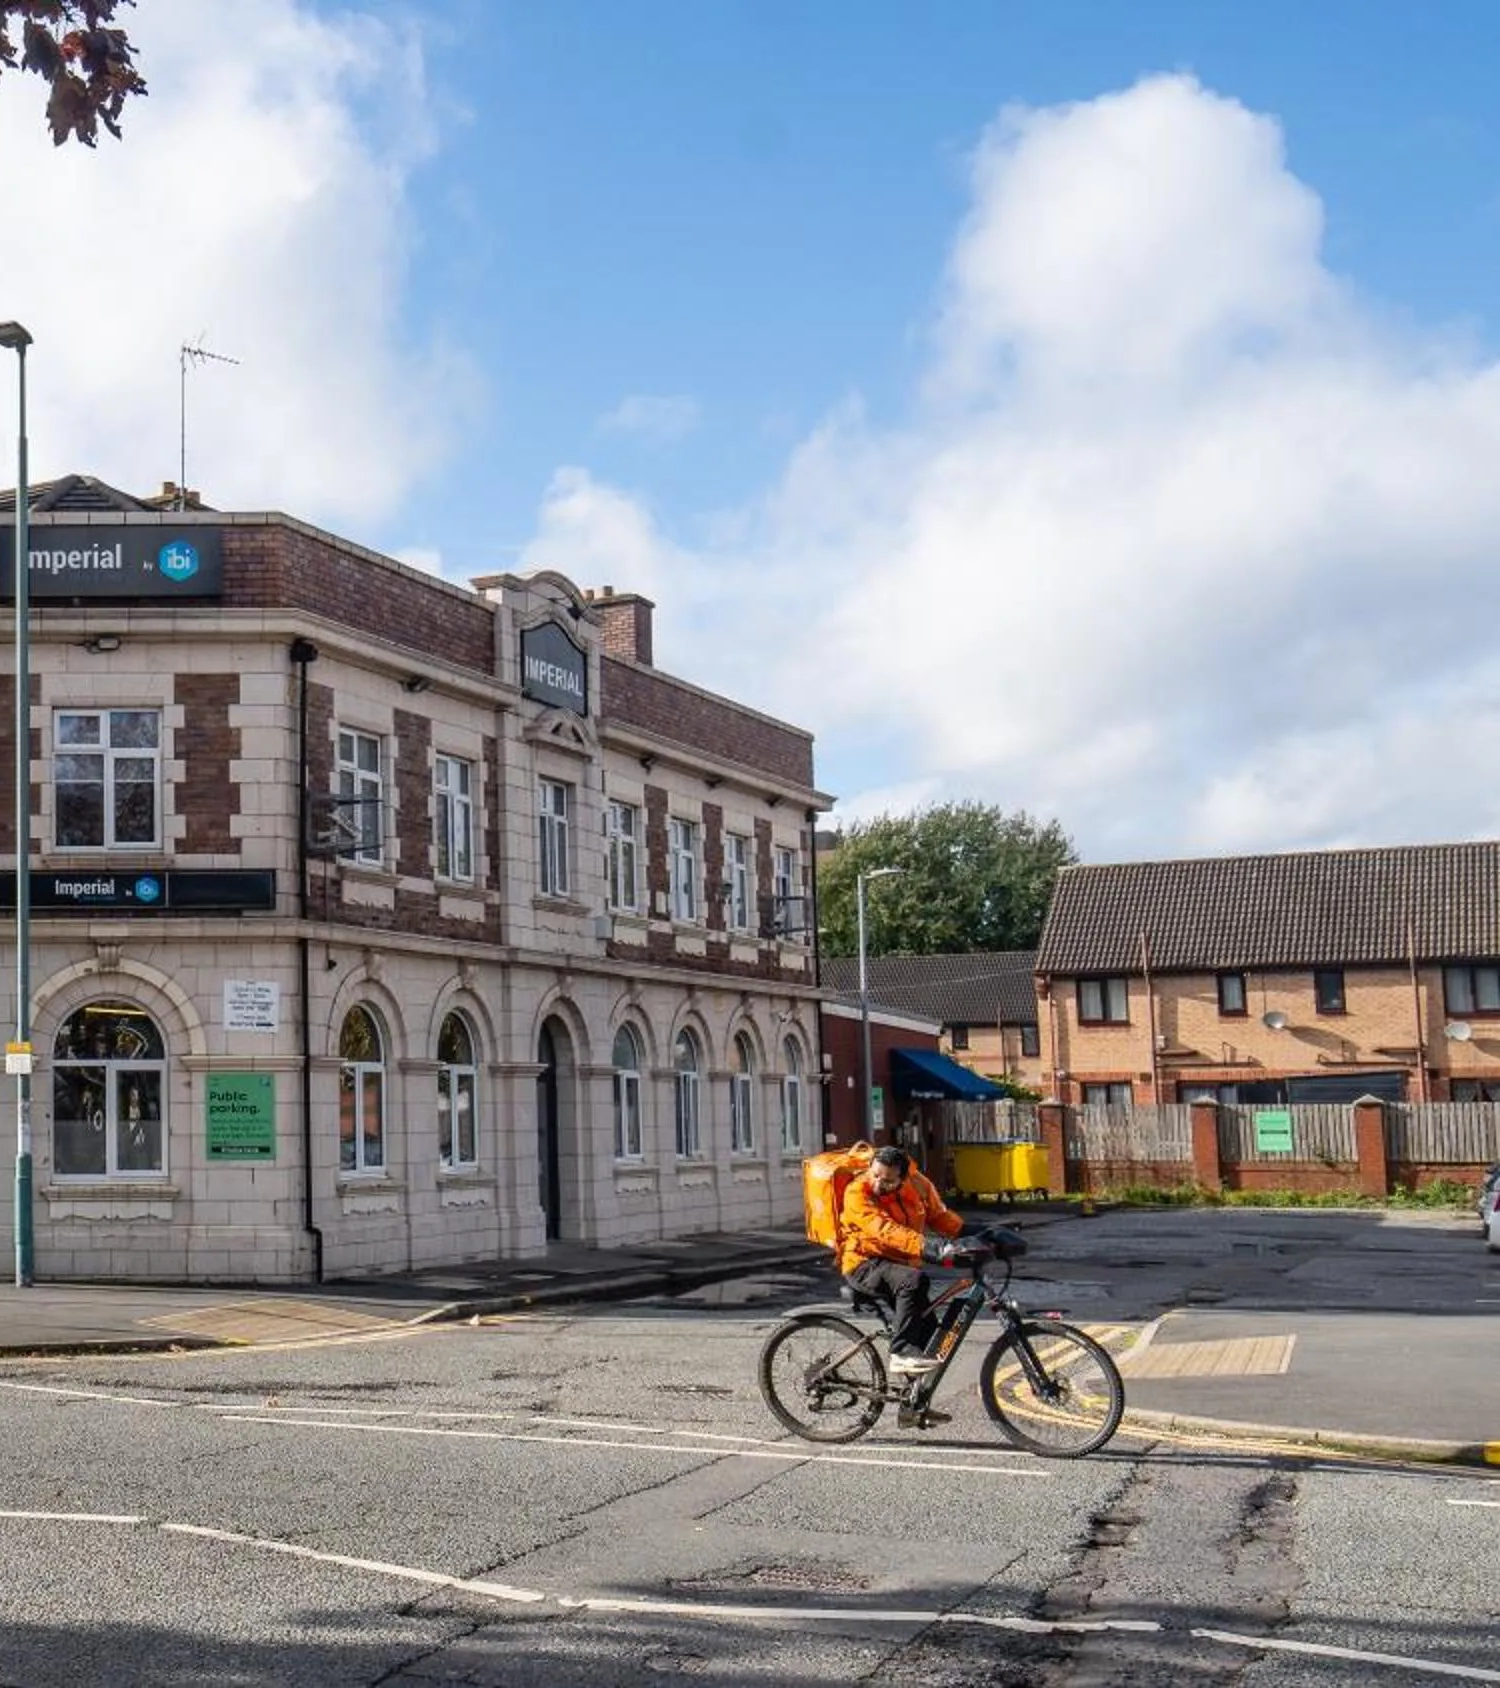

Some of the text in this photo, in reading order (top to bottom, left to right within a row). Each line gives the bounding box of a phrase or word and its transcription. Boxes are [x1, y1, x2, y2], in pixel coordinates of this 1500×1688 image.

[26, 543, 122, 575] mperial
[167, 548, 191, 569] ibi
[525, 655, 583, 697] IMPERIAL
[55, 879, 115, 899] Imperial
[210, 1091, 248, 1101] Public
[210, 1102, 261, 1115] parking.
